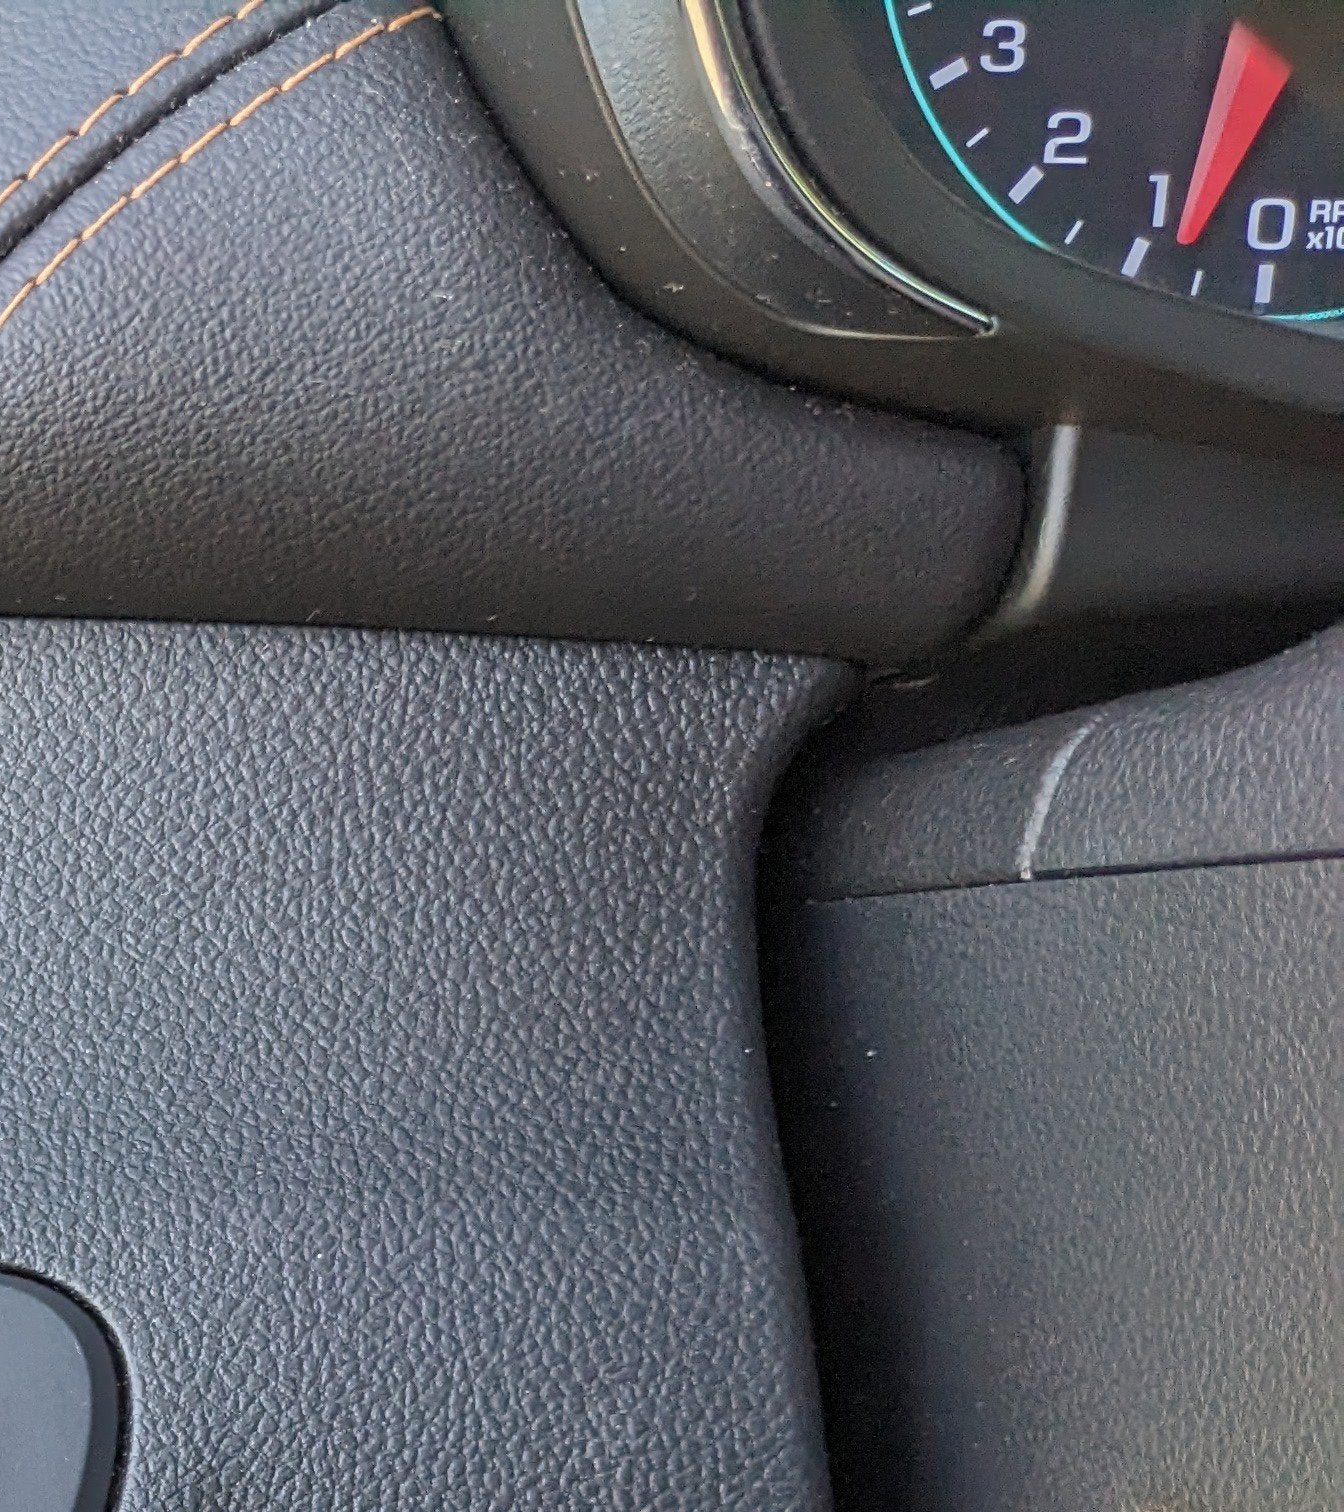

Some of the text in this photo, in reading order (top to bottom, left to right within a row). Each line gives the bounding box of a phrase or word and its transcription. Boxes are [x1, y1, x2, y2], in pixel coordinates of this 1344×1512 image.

[980, 19, 1027, 73] 3
[1043, 111, 1092, 164] 2
[1148, 174, 1170, 228] 1
[1247, 198, 1295, 250] 0
